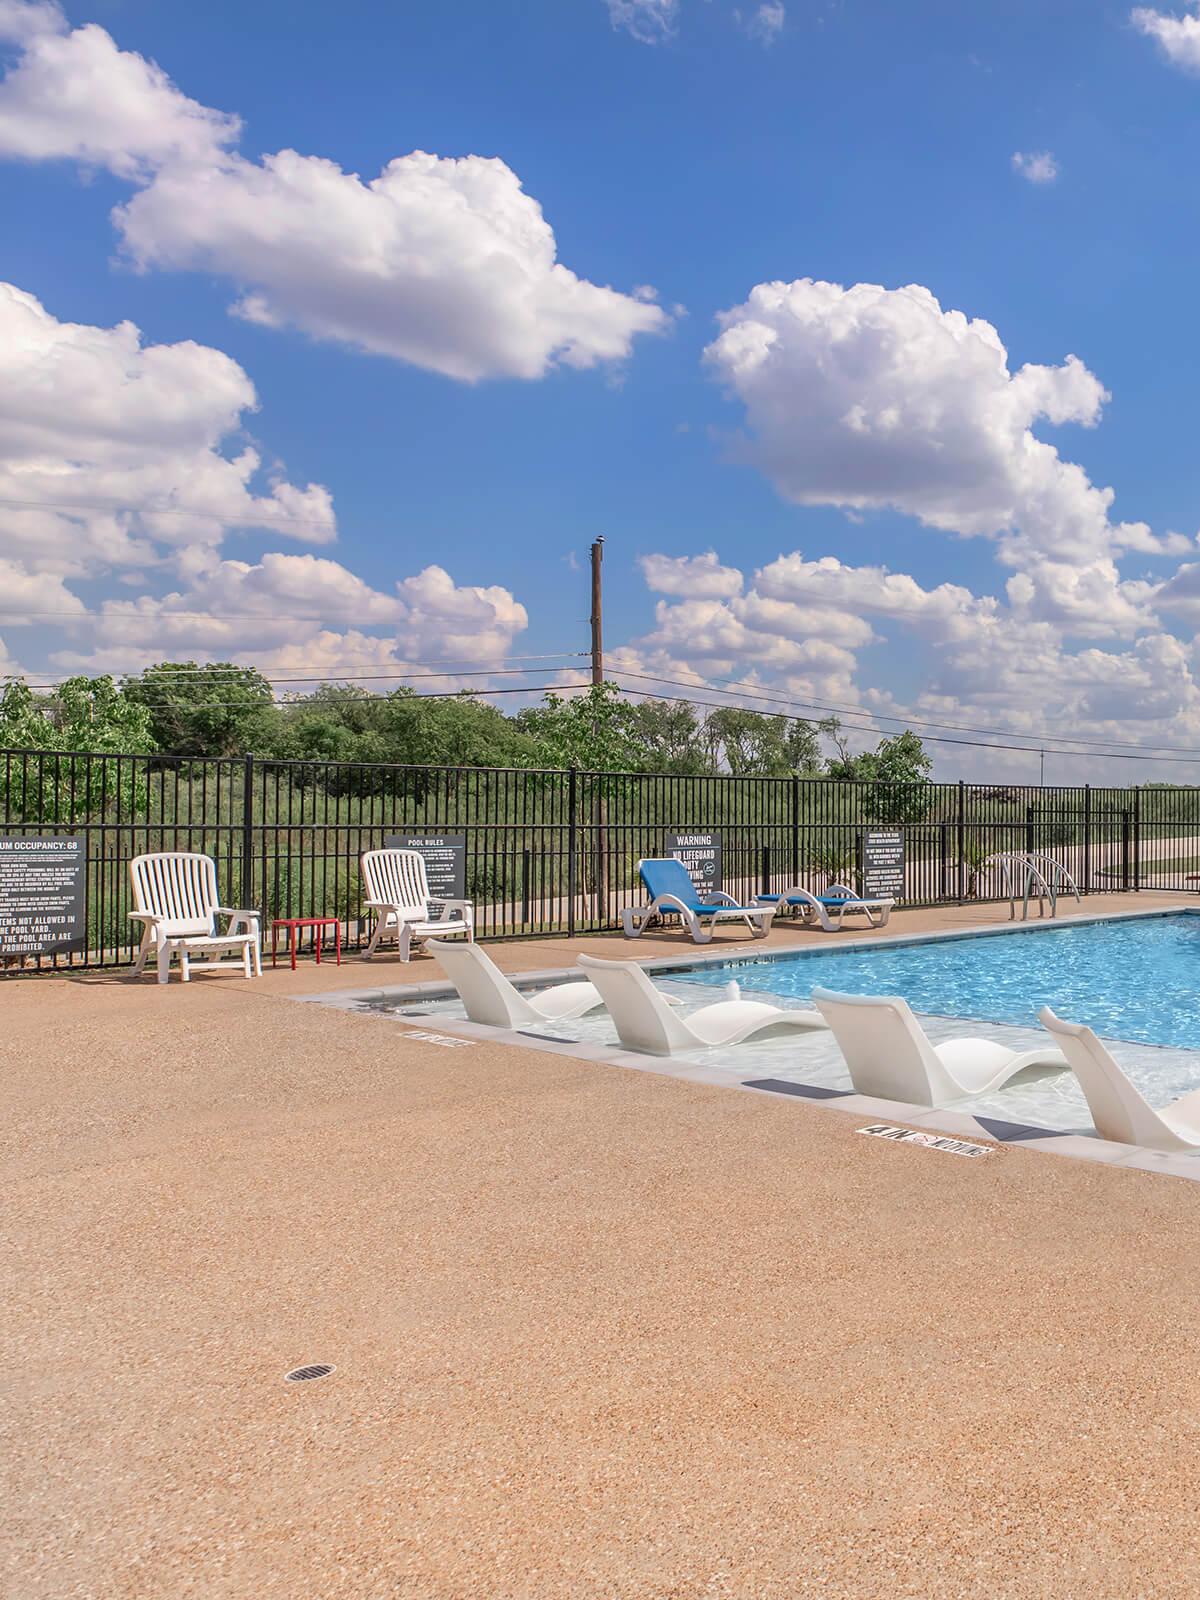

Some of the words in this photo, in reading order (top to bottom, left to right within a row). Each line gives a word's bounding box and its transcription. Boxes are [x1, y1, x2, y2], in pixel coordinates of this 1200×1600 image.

[14, 841, 66, 850] OCCUPANCY:
[67, 841, 78, 850] 68
[677, 835, 711, 846] WARNING
[673, 850, 682, 859] NO
[683, 849, 715, 860] LIFEGUARD
[18, 917, 33, 925] NOT
[34, 916, 66, 925] ALLOWED
[67, 915, 76, 923] IN
[11, 926, 29, 934] POOL
[31, 925, 51, 934] YARD.
[4, 935, 17, 943] THE
[19, 934, 37, 942] POOL
[38, 933, 57, 941] AREA
[58, 932, 72, 940] ARE
[2, 943, 45, 952] PROHIBITED.
